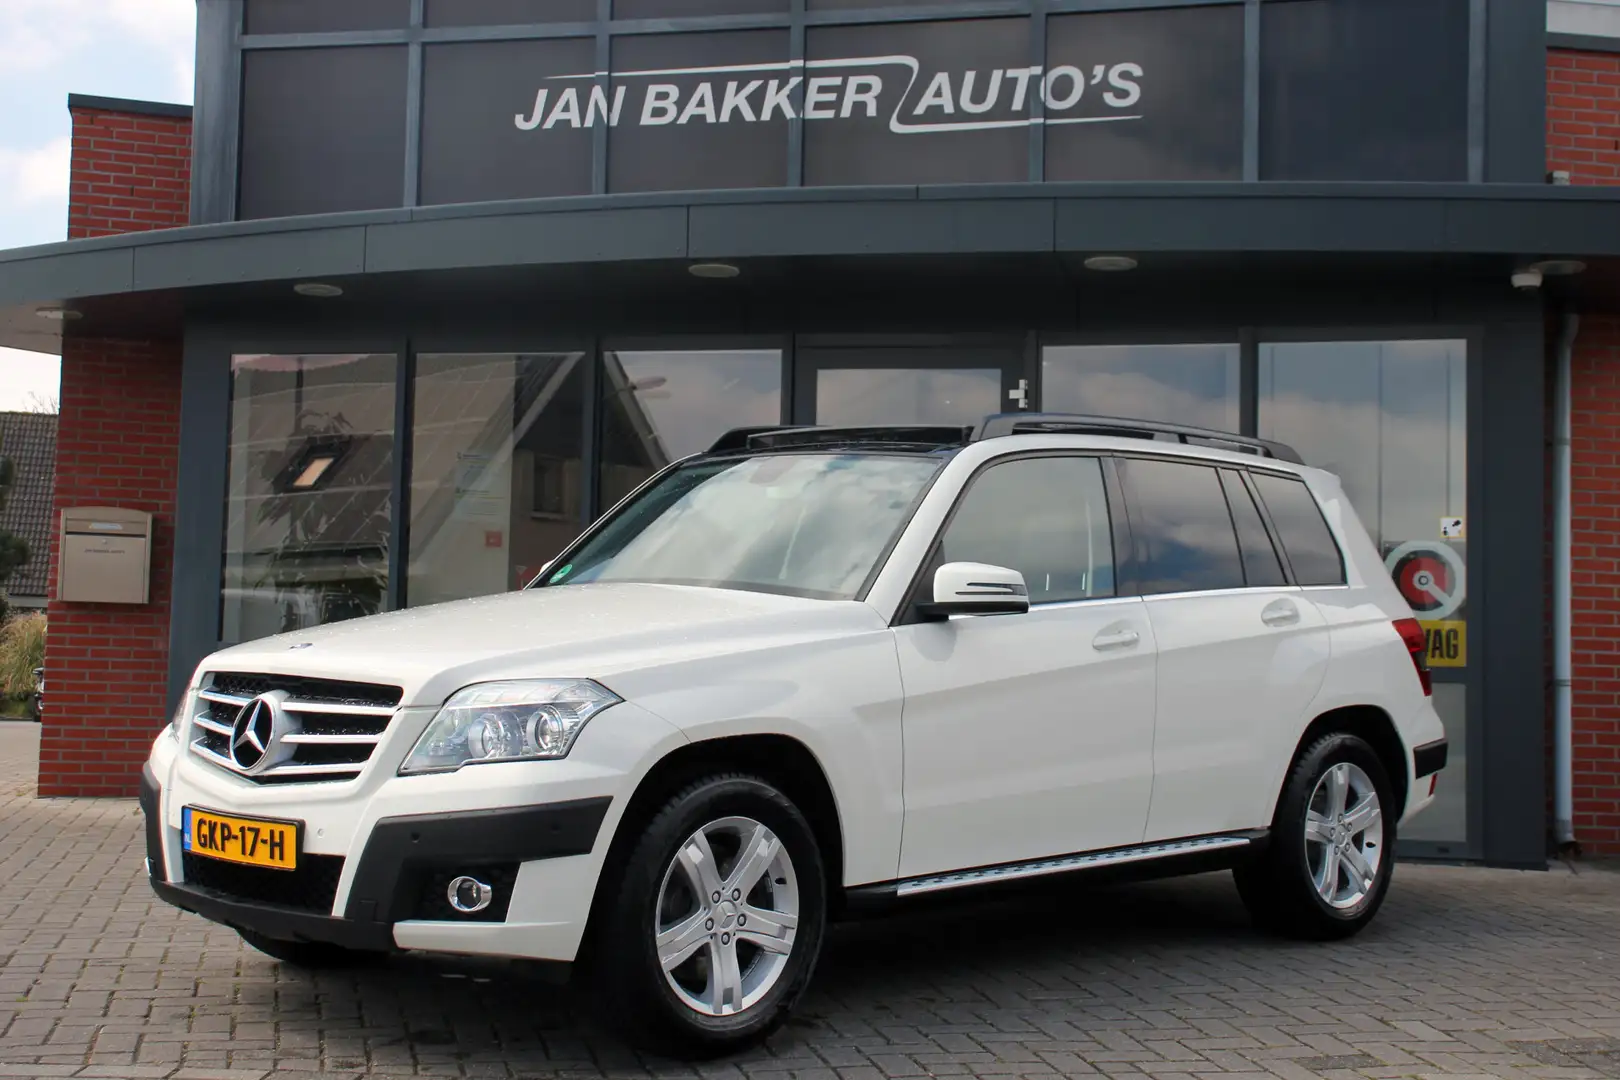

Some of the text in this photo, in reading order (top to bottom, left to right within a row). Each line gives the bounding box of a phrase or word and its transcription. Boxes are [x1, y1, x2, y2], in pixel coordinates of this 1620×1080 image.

[514, 62, 1144, 131] JAN BAKKER AUTO'S
[197, 818, 285, 861] GKP-17-H
